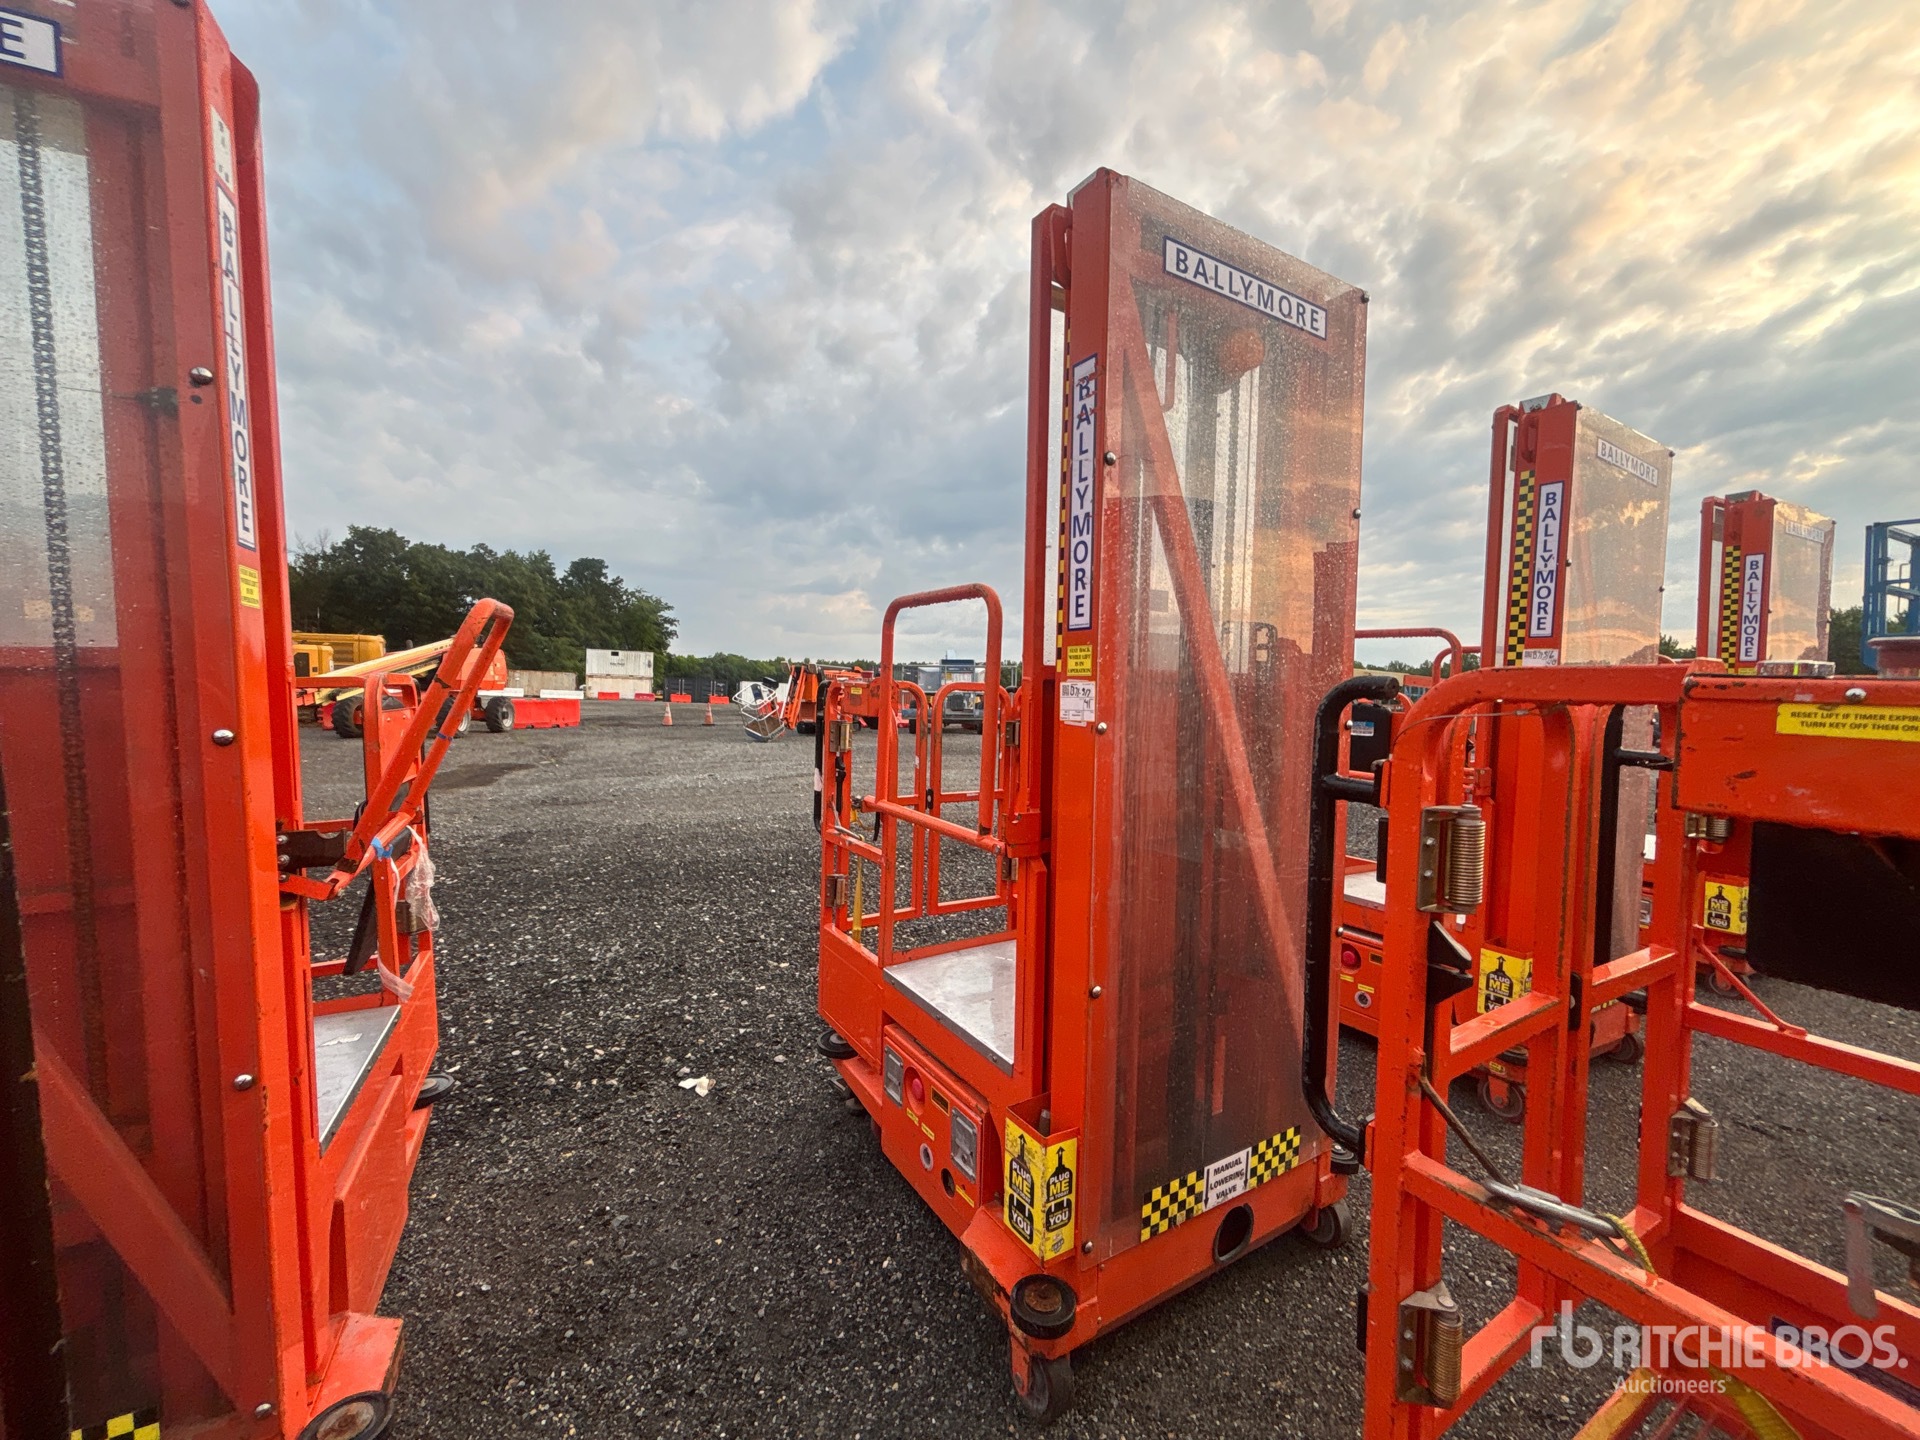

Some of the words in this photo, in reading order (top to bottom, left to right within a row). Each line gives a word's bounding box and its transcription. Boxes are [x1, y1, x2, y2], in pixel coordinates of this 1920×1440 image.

[1175, 247, 1320, 332] BALLYMORE
[222, 211, 250, 533] BALLYMORE
[1600, 442, 1656, 482] BALLYMORE
[1072, 377, 1092, 618] BALLYMORE
[1536, 491, 1557, 631] BALLYMORE
[1743, 560, 1760, 658] BALLYMORE
[1791, 711, 1818, 719] RESET
[1820, 712, 1840, 720] LIFT
[1842, 712, 1850, 720] IF
[1854, 713, 1886, 721] TIMER
[1800, 720, 1826, 729] TURN
[1829, 721, 1847, 730] KEY
[1849, 722, 1868, 730] OFF
[1871, 723, 1899, 731] THEN
[1711, 901, 1728, 910] ME
[1710, 918, 1728, 927] YOU
[1489, 974, 1511, 984] PLUG
[1489, 980, 1510, 992] ME
[1012, 1160, 1032, 1183] PLUG
[1213, 1157, 1242, 1176] MANUAL
[1012, 1171, 1031, 1199] ME
[1049, 1171, 1070, 1185] PLUG
[1209, 1168, 1245, 1190] LOWERING
[1049, 1181, 1070, 1195] ME
[1216, 1184, 1237, 1200] VALVE
[1011, 1210, 1031, 1235] YOU
[1049, 1210, 1069, 1226] YOU
